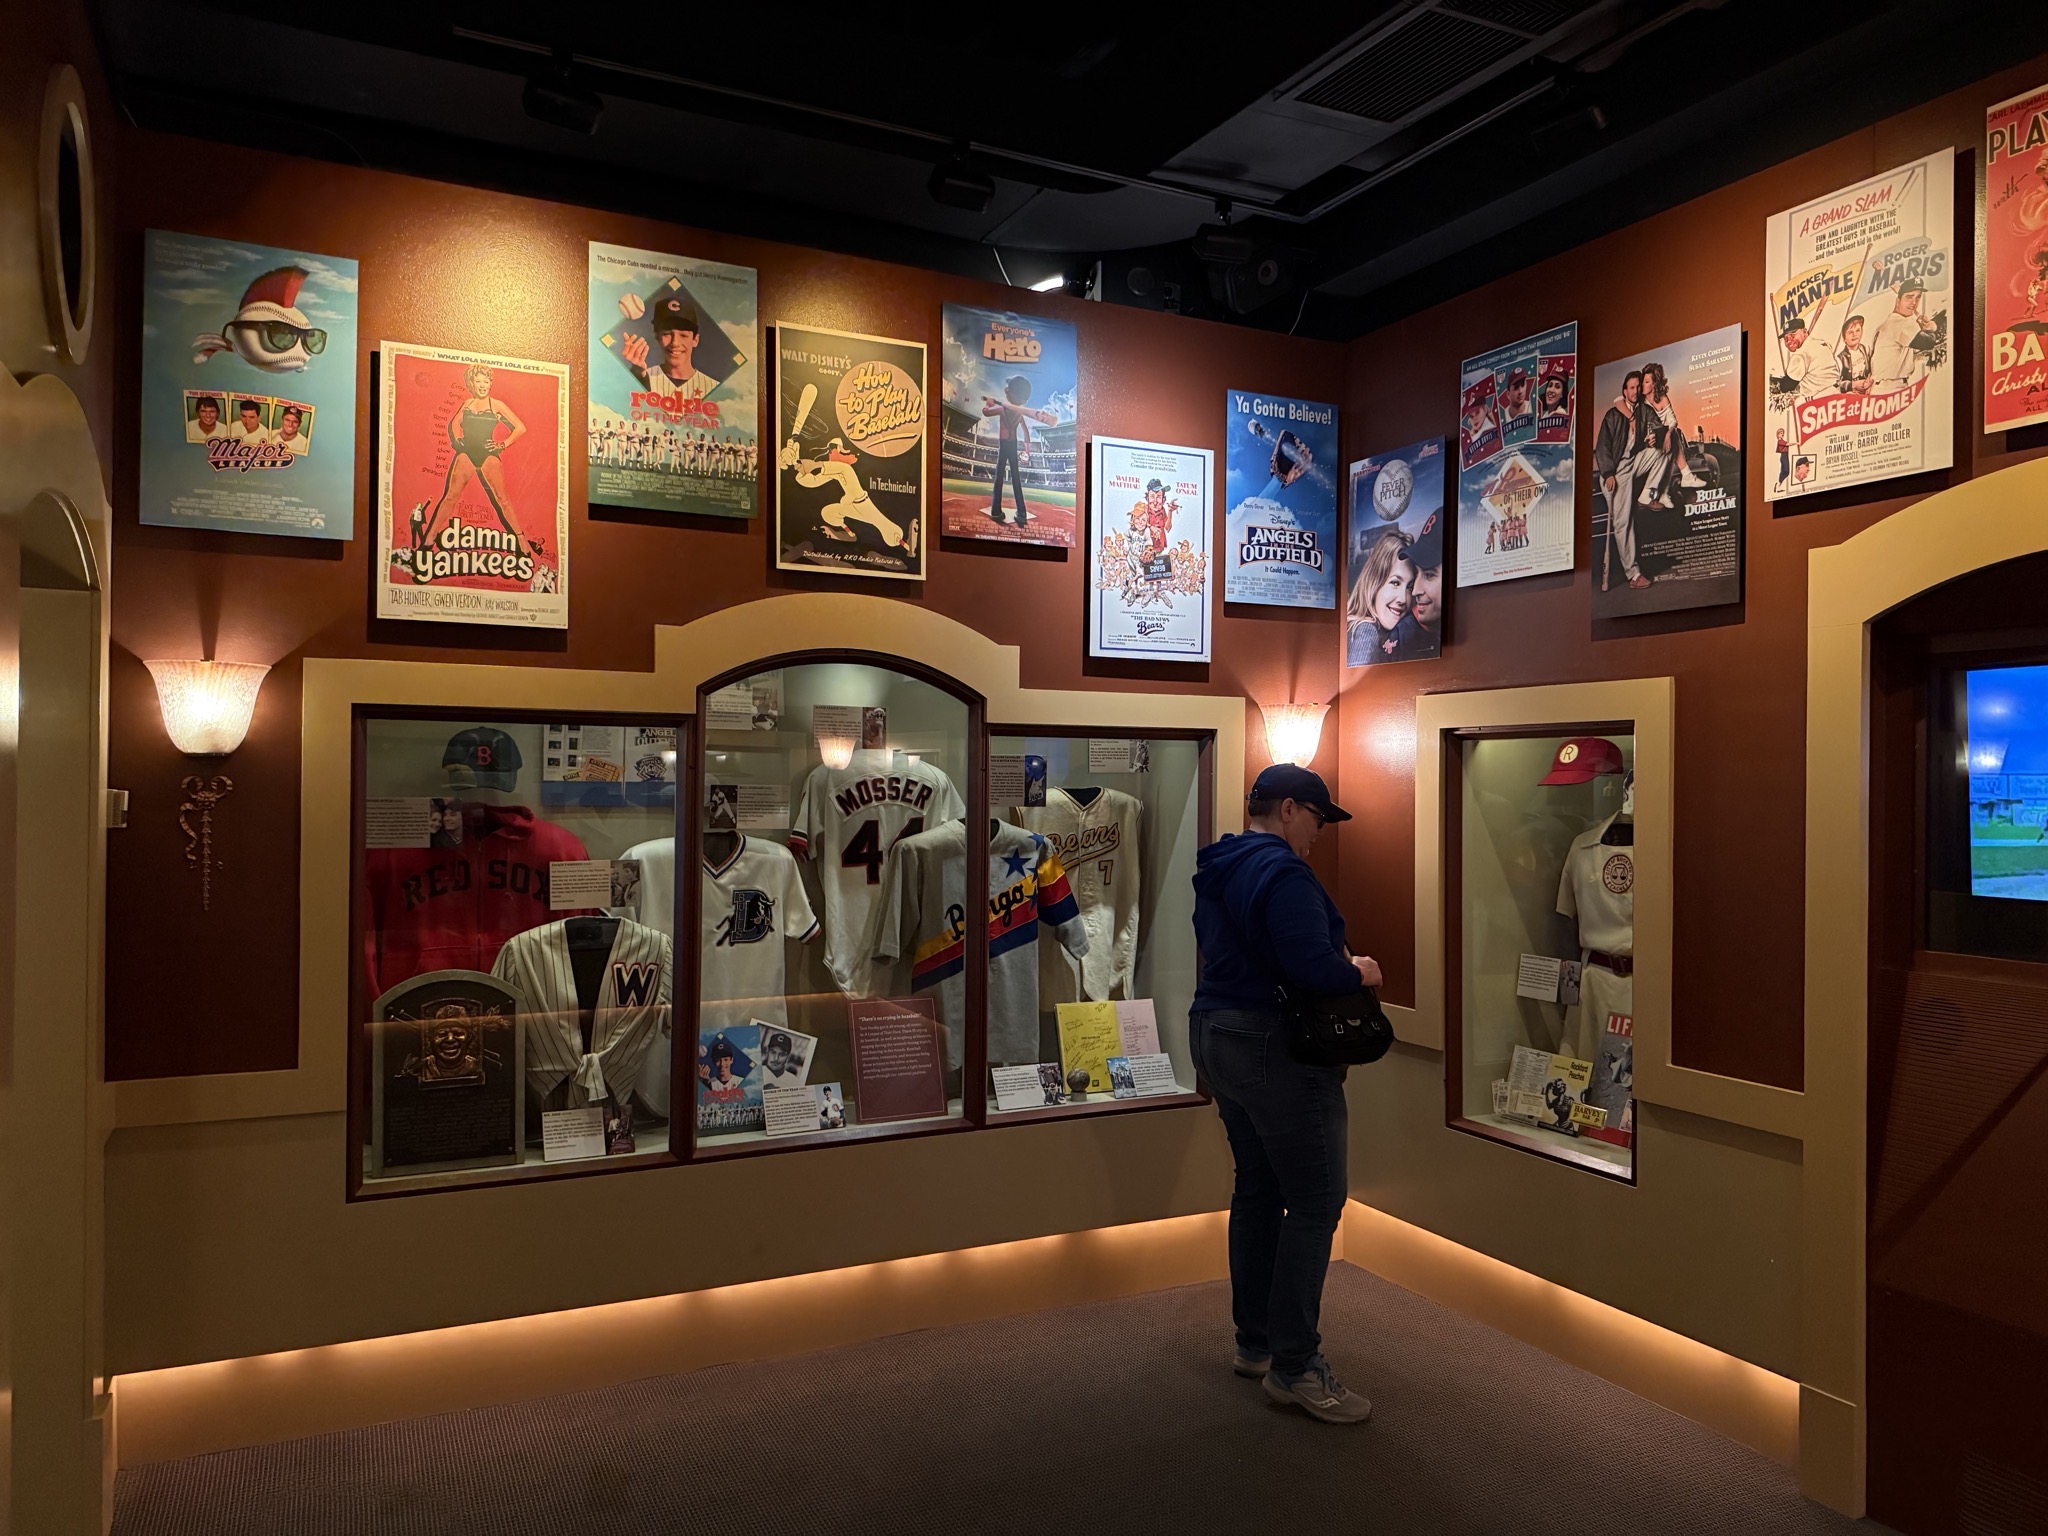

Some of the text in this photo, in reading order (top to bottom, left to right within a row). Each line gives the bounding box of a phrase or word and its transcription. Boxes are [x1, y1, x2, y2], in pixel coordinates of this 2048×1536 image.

[1800, 185, 1892, 237] A GRAND SLAM
[1816, 208, 1897, 243] FUN AND LAUGHTER WITH THE
[1816, 237, 1842, 251] GREATEST
[1844, 233, 1858, 243] GUYS
[1869, 218, 1896, 234] BASEBALL
[1826, 225, 1900, 257] the luckiest kid in the world!
[608, 256, 626, 265] Chicago
[627, 259, 639, 267] Cubs
[640, 262, 657, 270] needed
[1884, 244, 1928, 267] ROGER
[1868, 252, 1945, 293] MARIS
[1787, 269, 1829, 300] MICKEY
[1780, 271, 1854, 329] MANTLE
[992, 322, 1035, 336] Everyone's
[984, 333, 1042, 361] Hero
[1518, 346, 1527, 354] TEAM
[1527, 343, 1536, 351] THAT
[1537, 336, 1553, 347] BROUGHT
[1692, 346, 1731, 362] KEVIN COSTNER
[437, 353, 460, 361] WHAT
[480, 358, 503, 366] WANTS
[782, 348, 852, 370] WALT DISNEY'S
[1689, 354, 1734, 371] SUSAN SARANDON
[853, 363, 892, 391] How
[1992, 367, 2047, 396] Christy
[630, 388, 720, 418] rookie
[840, 384, 908, 417] to Play
[1235, 395, 1332, 425] Ya Gotta Believe!
[1802, 385, 1916, 434] SAFE at HOME!
[630, 410, 719, 429] OF THE YEAR
[847, 395, 921, 440] Baseball
[1892, 423, 1902, 432] DON
[1503, 424, 1512, 433] TOM
[1830, 434, 1849, 443] WILLIAM
[1858, 428, 1878, 438] PATRICIA
[1826, 442, 1853, 455] FRAWLEY
[1858, 436, 1878, 449] BARRY
[1883, 429, 1910, 443] COLLIER
[206, 437, 288, 474] Major
[1826, 451, 1858, 465] BRYAN RUSSELL
[870, 477, 916, 494] In Technicolor
[1380, 486, 1406, 502] PITCH
[1382, 478, 1406, 492] FEVER
[1504, 484, 1549, 504] OF THEIR OWN
[1696, 488, 1726, 502] BULL
[1684, 498, 1736, 516] DURHAM
[1269, 514, 1295, 527] Disney's
[1422, 515, 1436, 534] B
[441, 518, 516, 551] damn
[1251, 528, 1313, 548] ANGELS
[803, 550, 834, 559] Distributed
[1242, 545, 1322, 568] OUTFIELD
[416, 551, 534, 582] yankees
[1283, 567, 1300, 576] Happen.
[391, 590, 403, 604] TAB
[404, 591, 432, 607] HUNTER
[434, 592, 454, 607] GWEN
[455, 594, 482, 609] VERDON
[477, 746, 492, 766] B
[1563, 746, 1573, 760] R
[835, 775, 933, 816] MOSSER
[1047, 822, 1120, 858] Bears
[1100, 860, 1112, 885] 7
[401, 860, 470, 912] RED
[488, 860, 551, 902] SOX
[612, 962, 659, 1008] W
[1608, 1016, 1632, 1036] LIF
[1569, 1071, 1584, 1082] Peaches
[1571, 1062, 1588, 1073] Rockford
[1574, 1105, 1601, 1117] HARVEY
